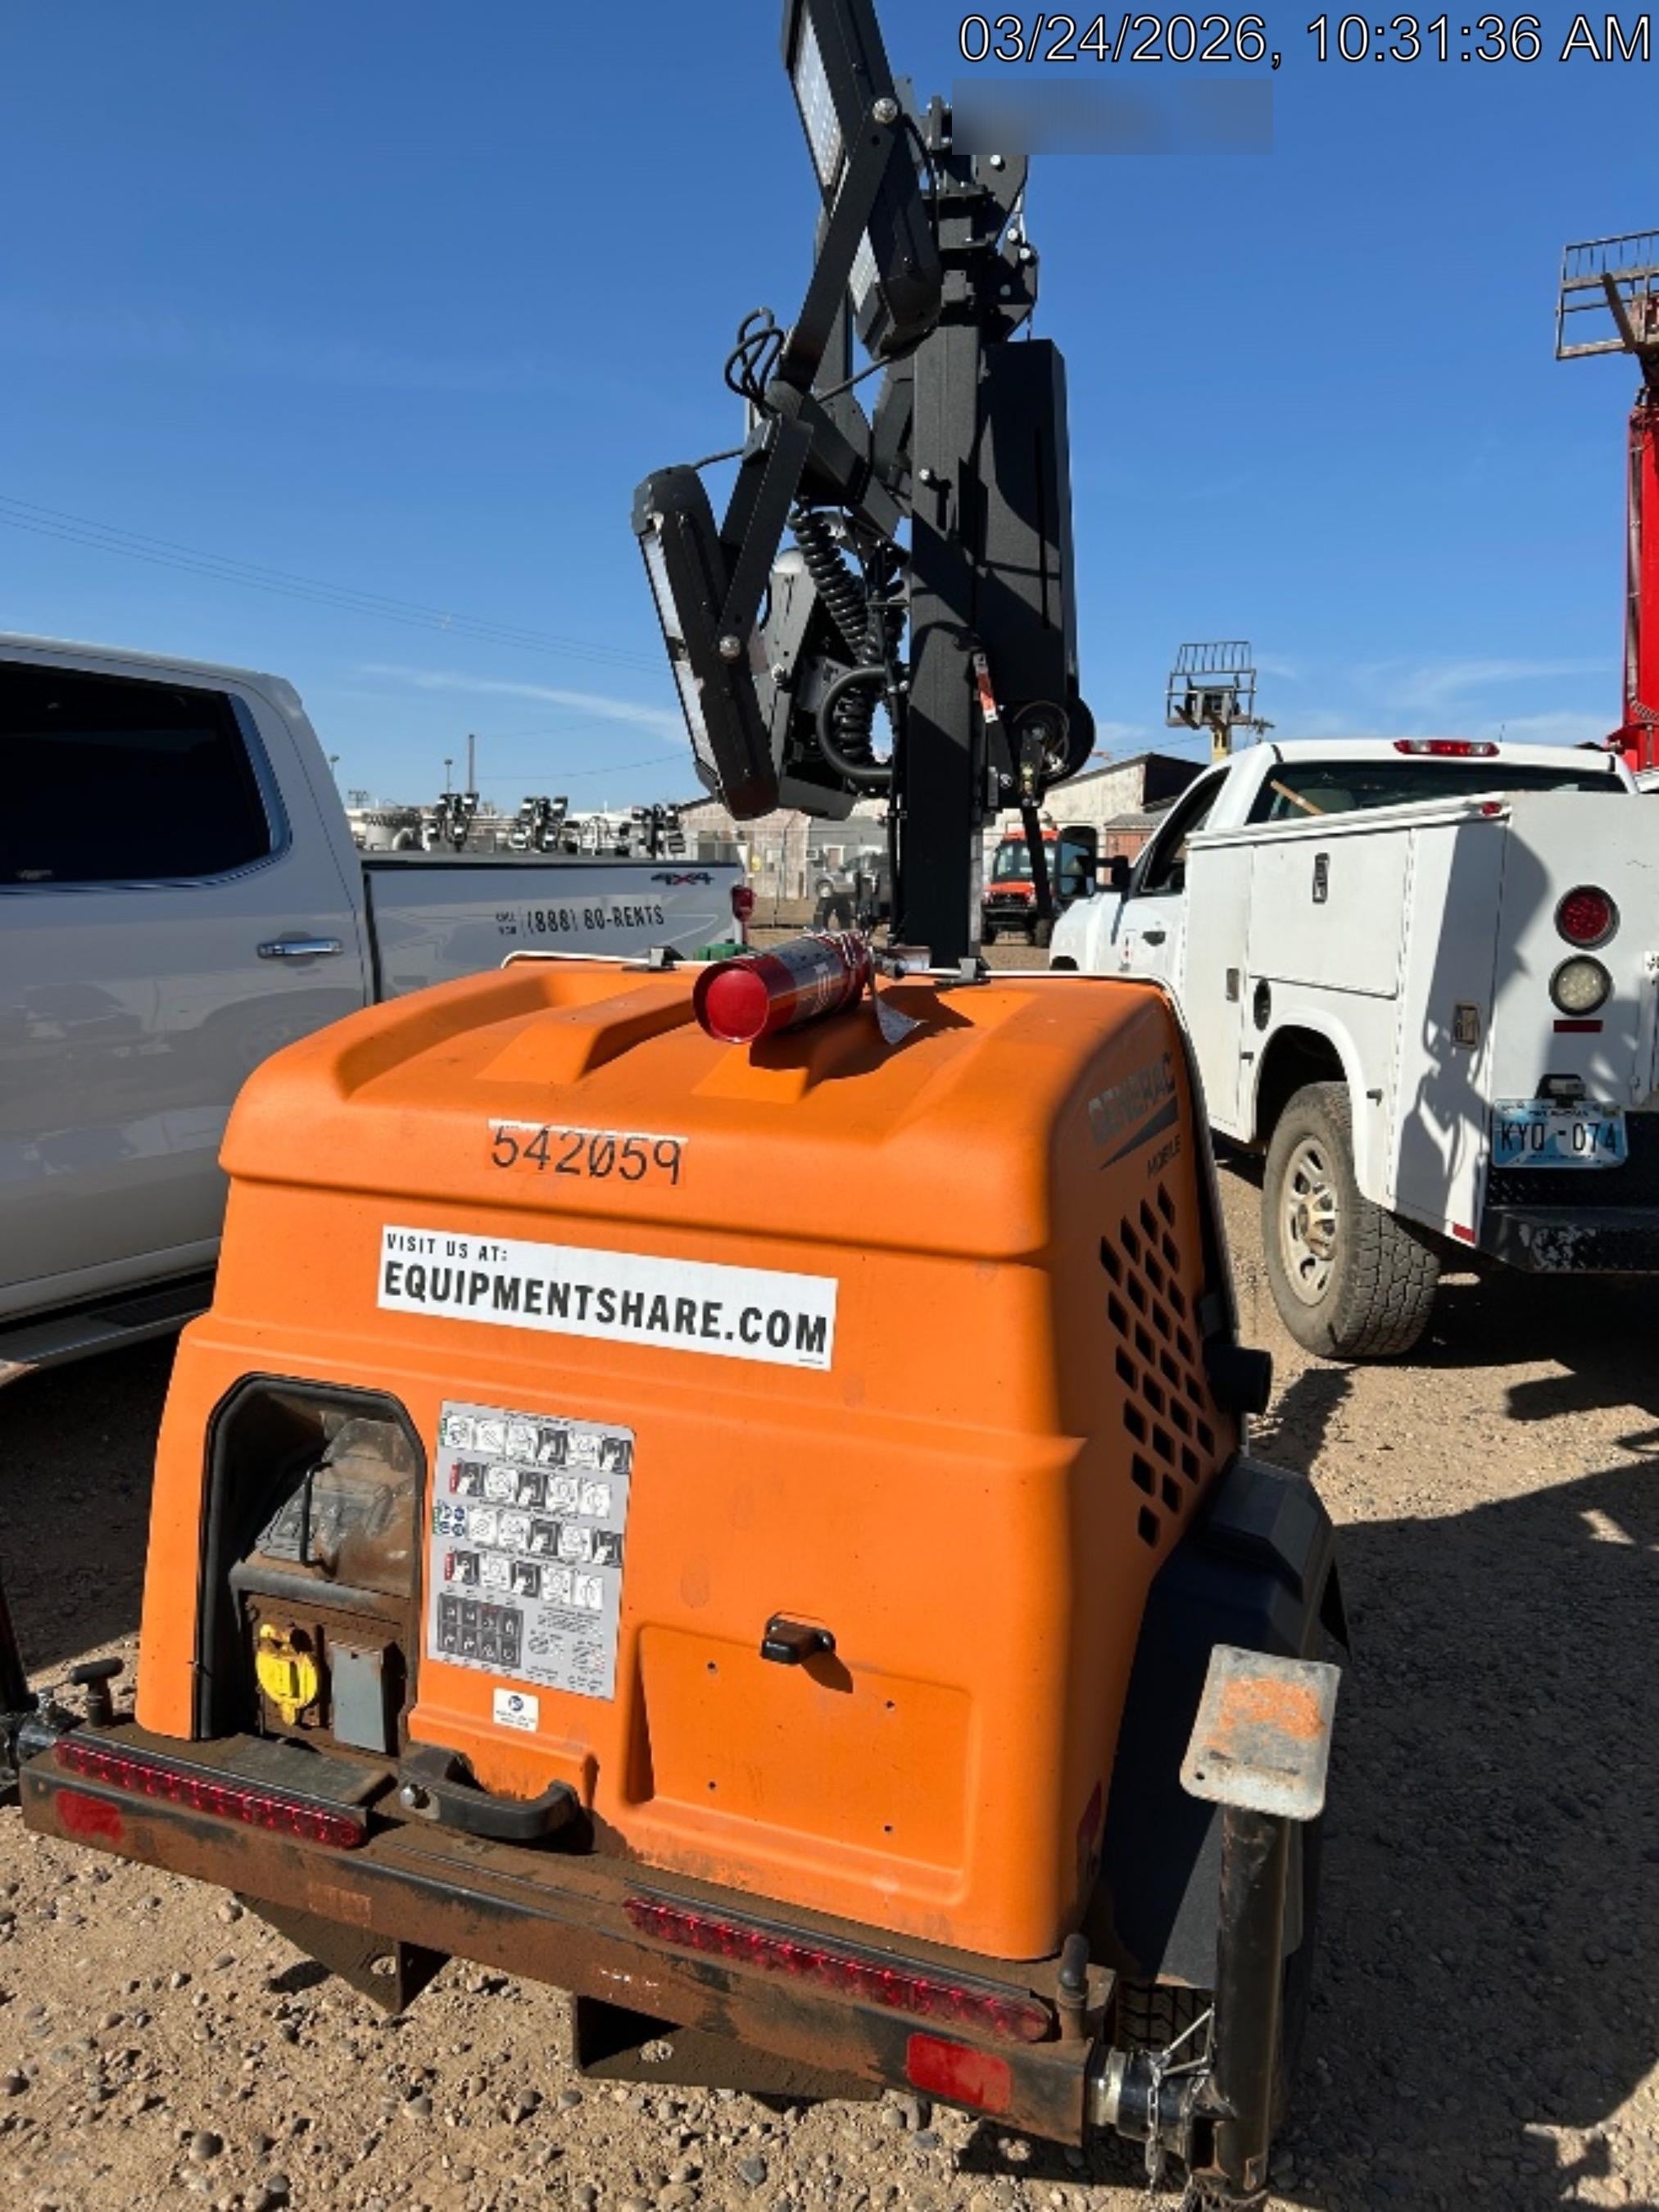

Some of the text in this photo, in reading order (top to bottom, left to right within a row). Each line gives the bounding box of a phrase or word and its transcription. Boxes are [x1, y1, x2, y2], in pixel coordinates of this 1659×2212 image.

[492, 1126, 682, 1185] 542059
[387, 1233, 509, 1262] VISIT US AT:
[383, 1261, 828, 1354] EQUIPMENTSHARE.COM
